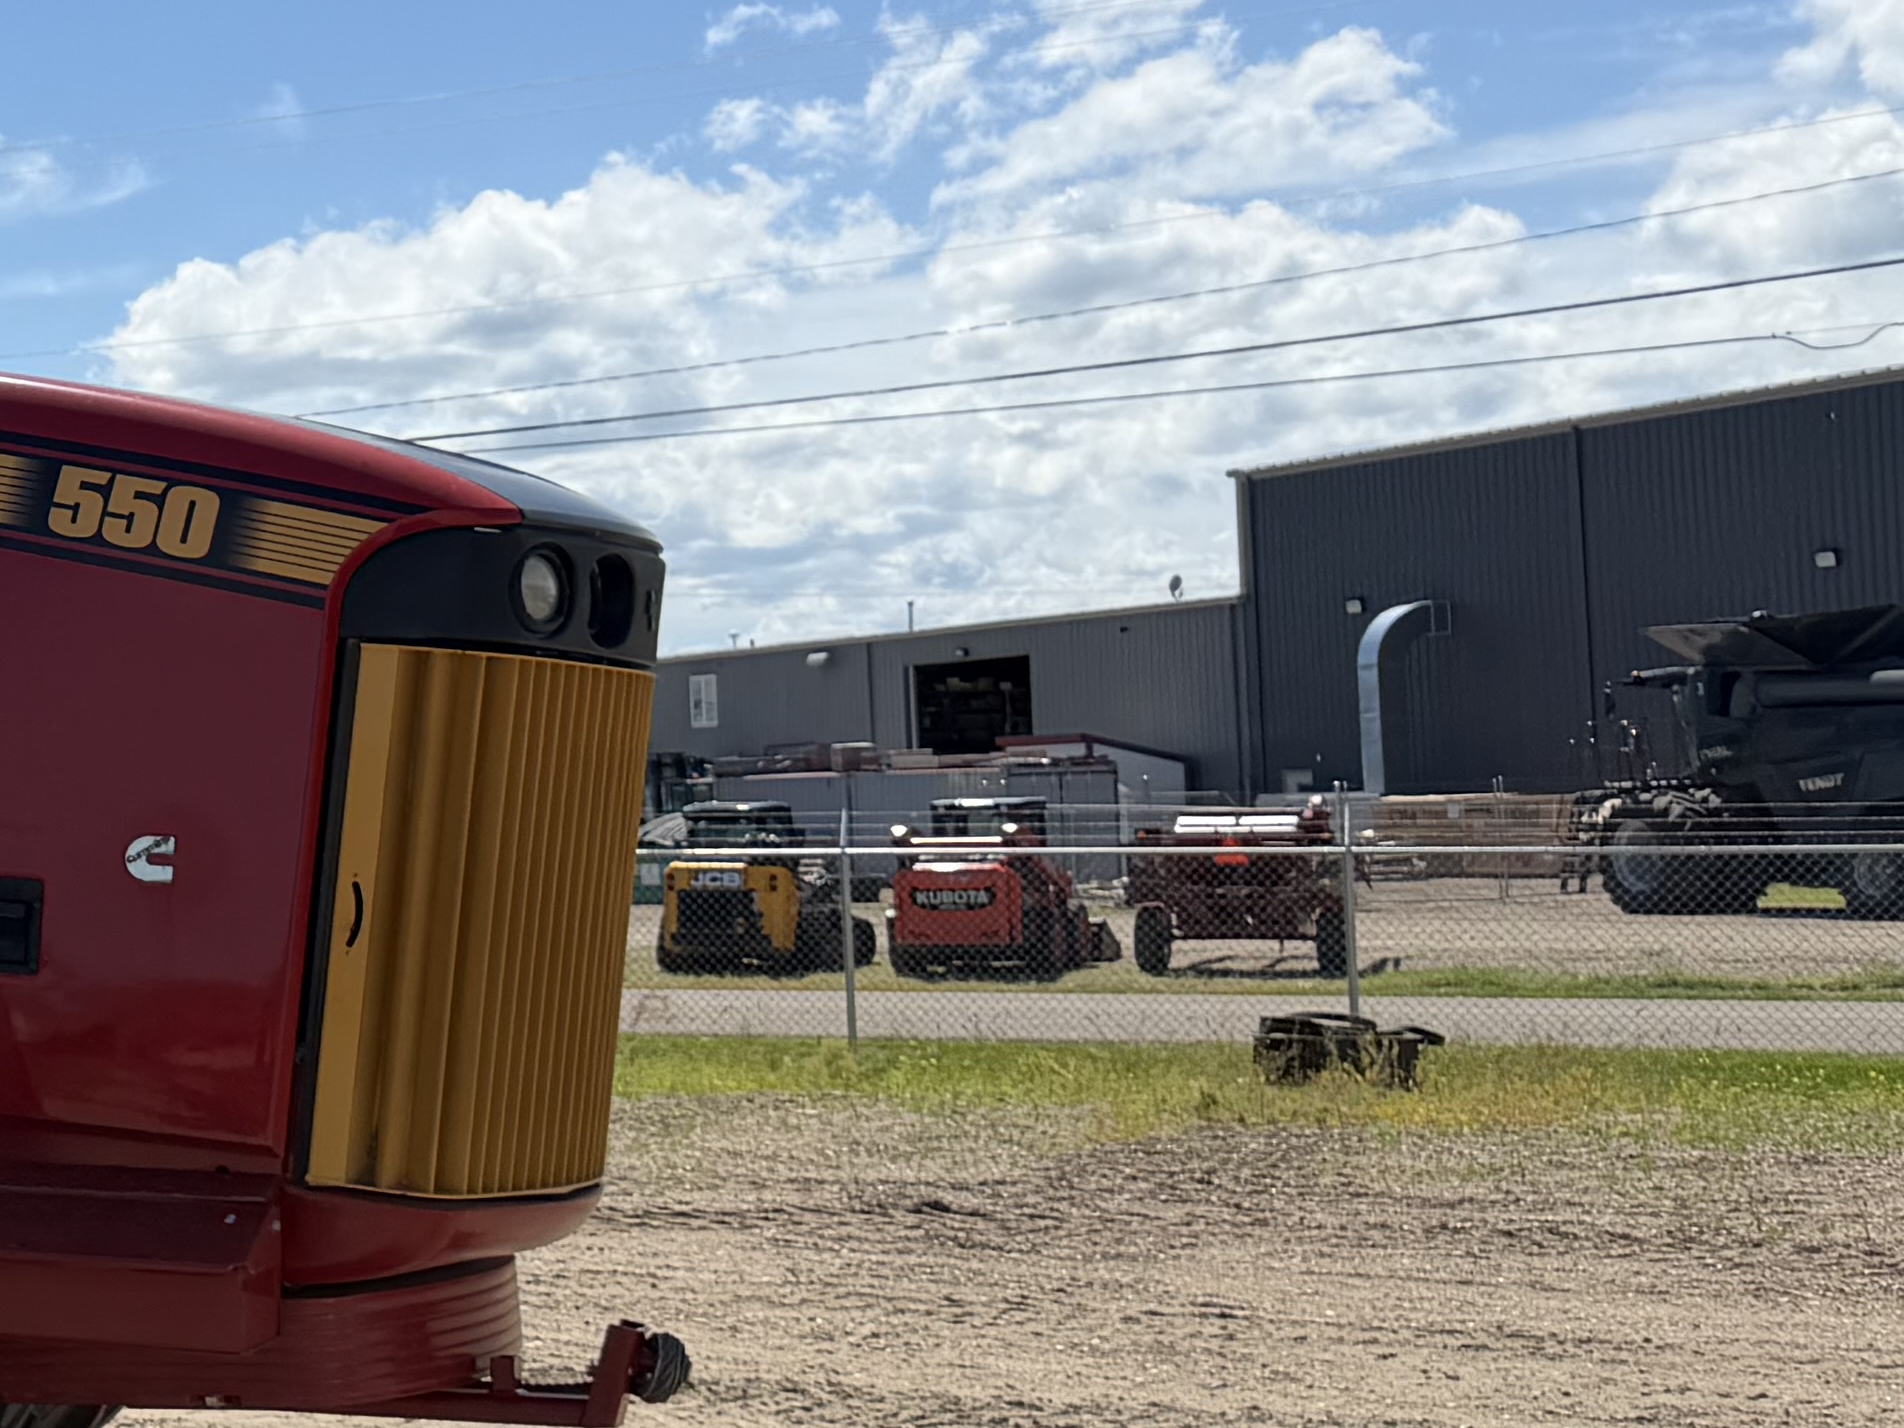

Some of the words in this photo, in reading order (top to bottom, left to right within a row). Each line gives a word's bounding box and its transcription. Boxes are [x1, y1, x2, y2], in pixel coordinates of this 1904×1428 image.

[47, 464, 221, 560] 550
[690, 872, 742, 888] JCB
[914, 889, 990, 905] KUBOTA
